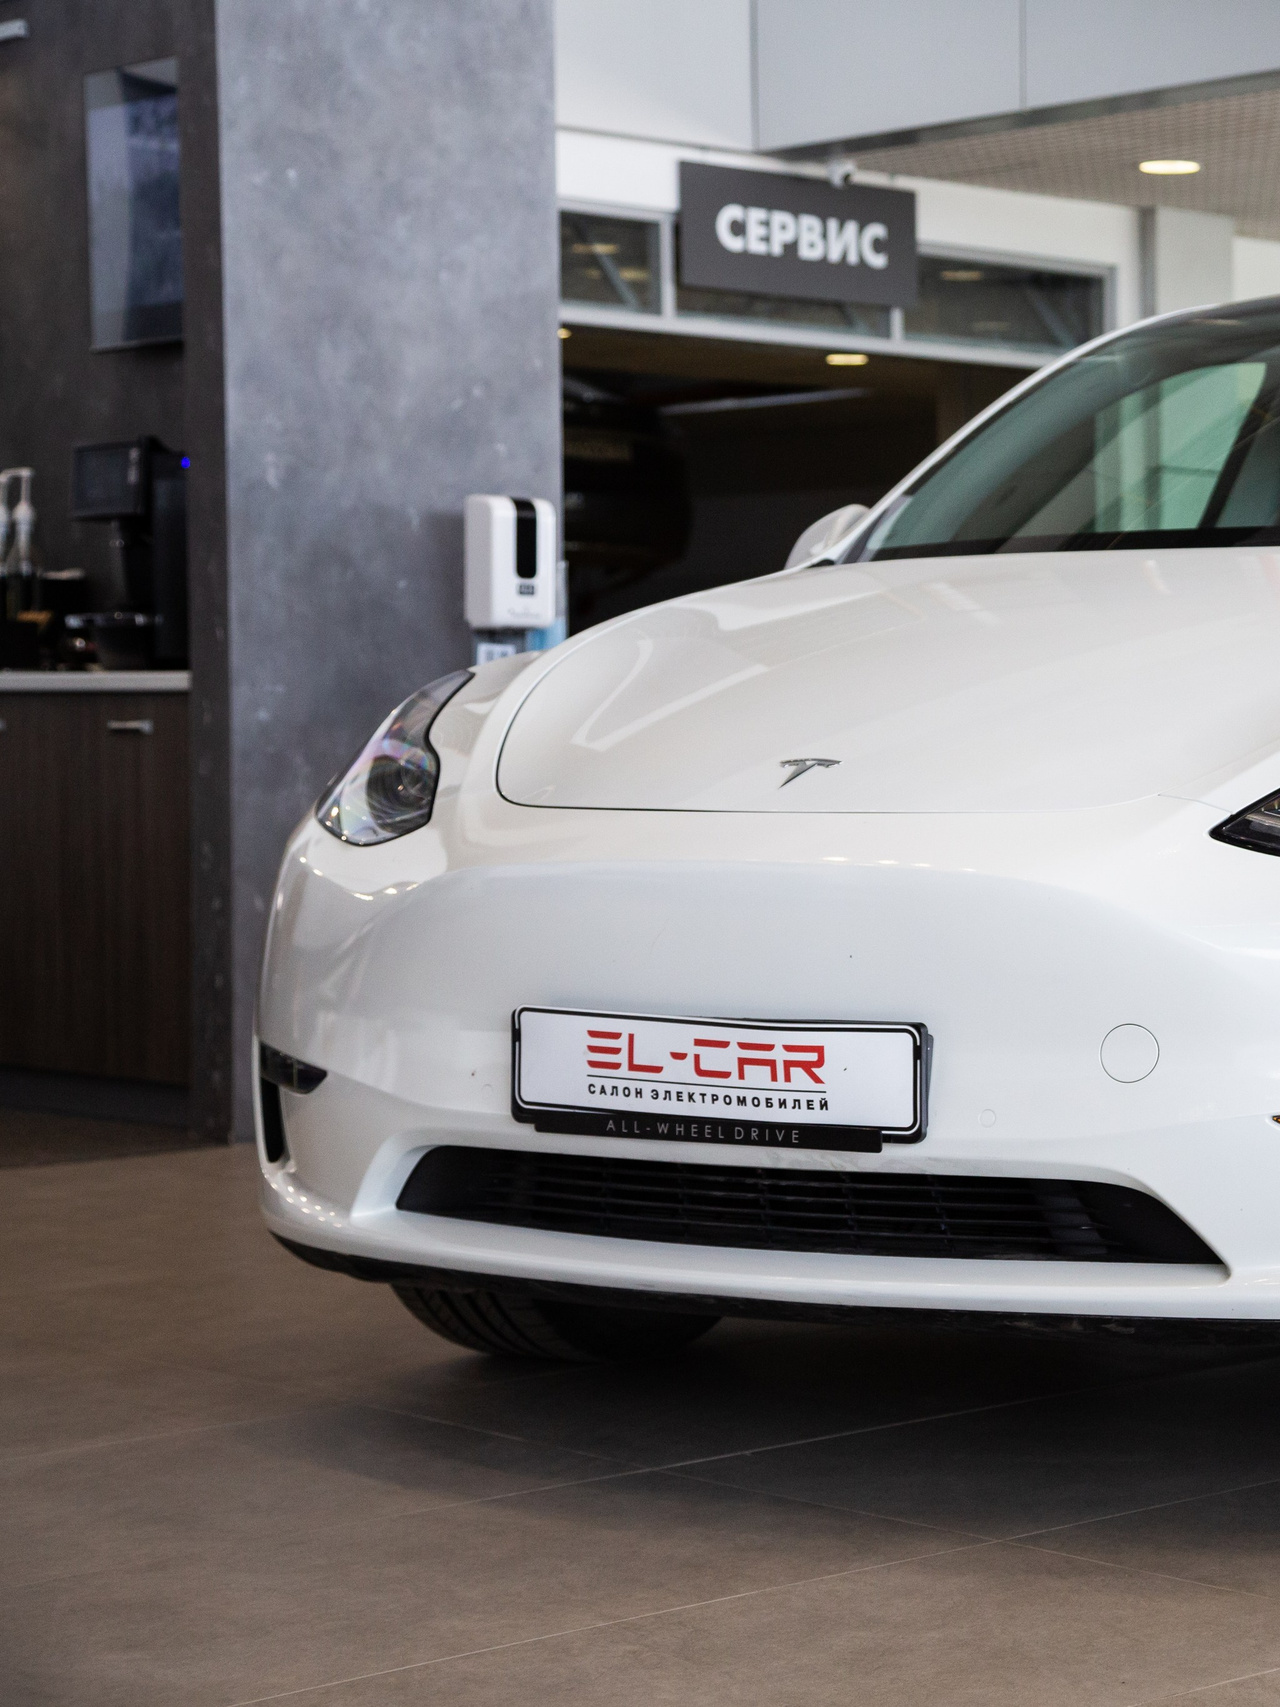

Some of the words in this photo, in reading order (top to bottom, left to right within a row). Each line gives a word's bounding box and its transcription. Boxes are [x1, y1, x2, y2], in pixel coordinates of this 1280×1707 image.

[715, 203, 888, 270] СЕРВИС
[587, 1030, 825, 1084] EL-CAR
[588, 1083, 643, 1099] САЛОН
[651, 1089, 829, 1111] ЭЛЕКТРОМОБИЛЕЙ
[607, 1120, 725, 1139] ALL-WHEEL
[734, 1127, 799, 1143] DRIVE
